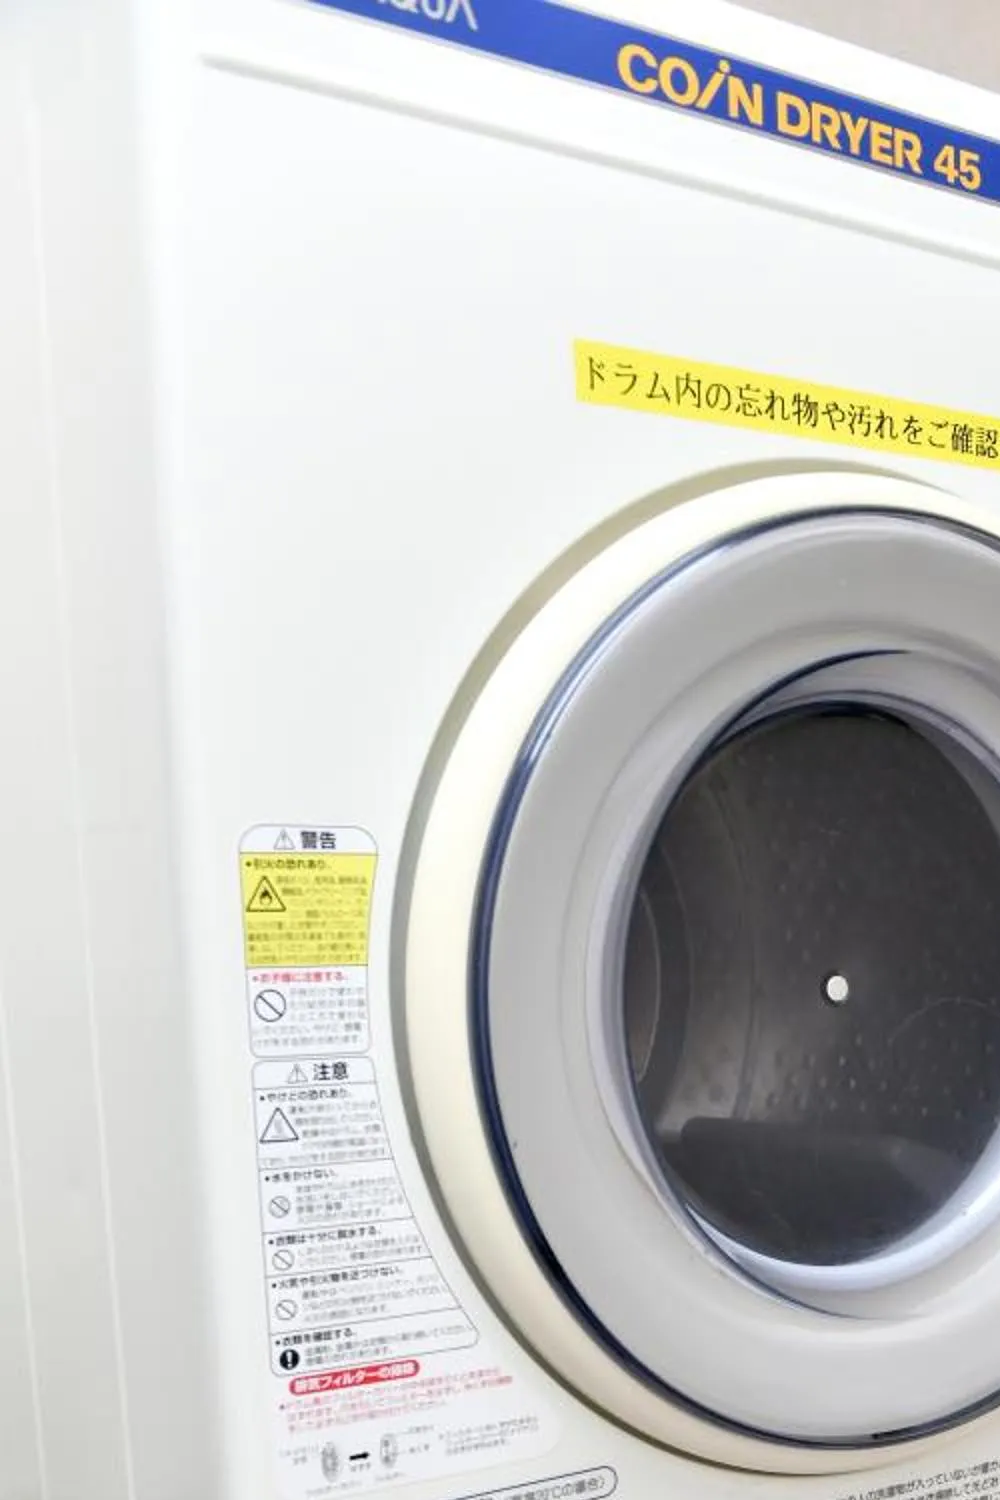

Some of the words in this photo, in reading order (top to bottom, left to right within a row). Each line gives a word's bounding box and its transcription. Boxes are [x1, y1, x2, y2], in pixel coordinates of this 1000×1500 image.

[776, 91, 922, 174] DRYER
[933, 145, 981, 190] 45
[301, 831, 336, 850] 警告
[312, 1062, 349, 1081] 注意
